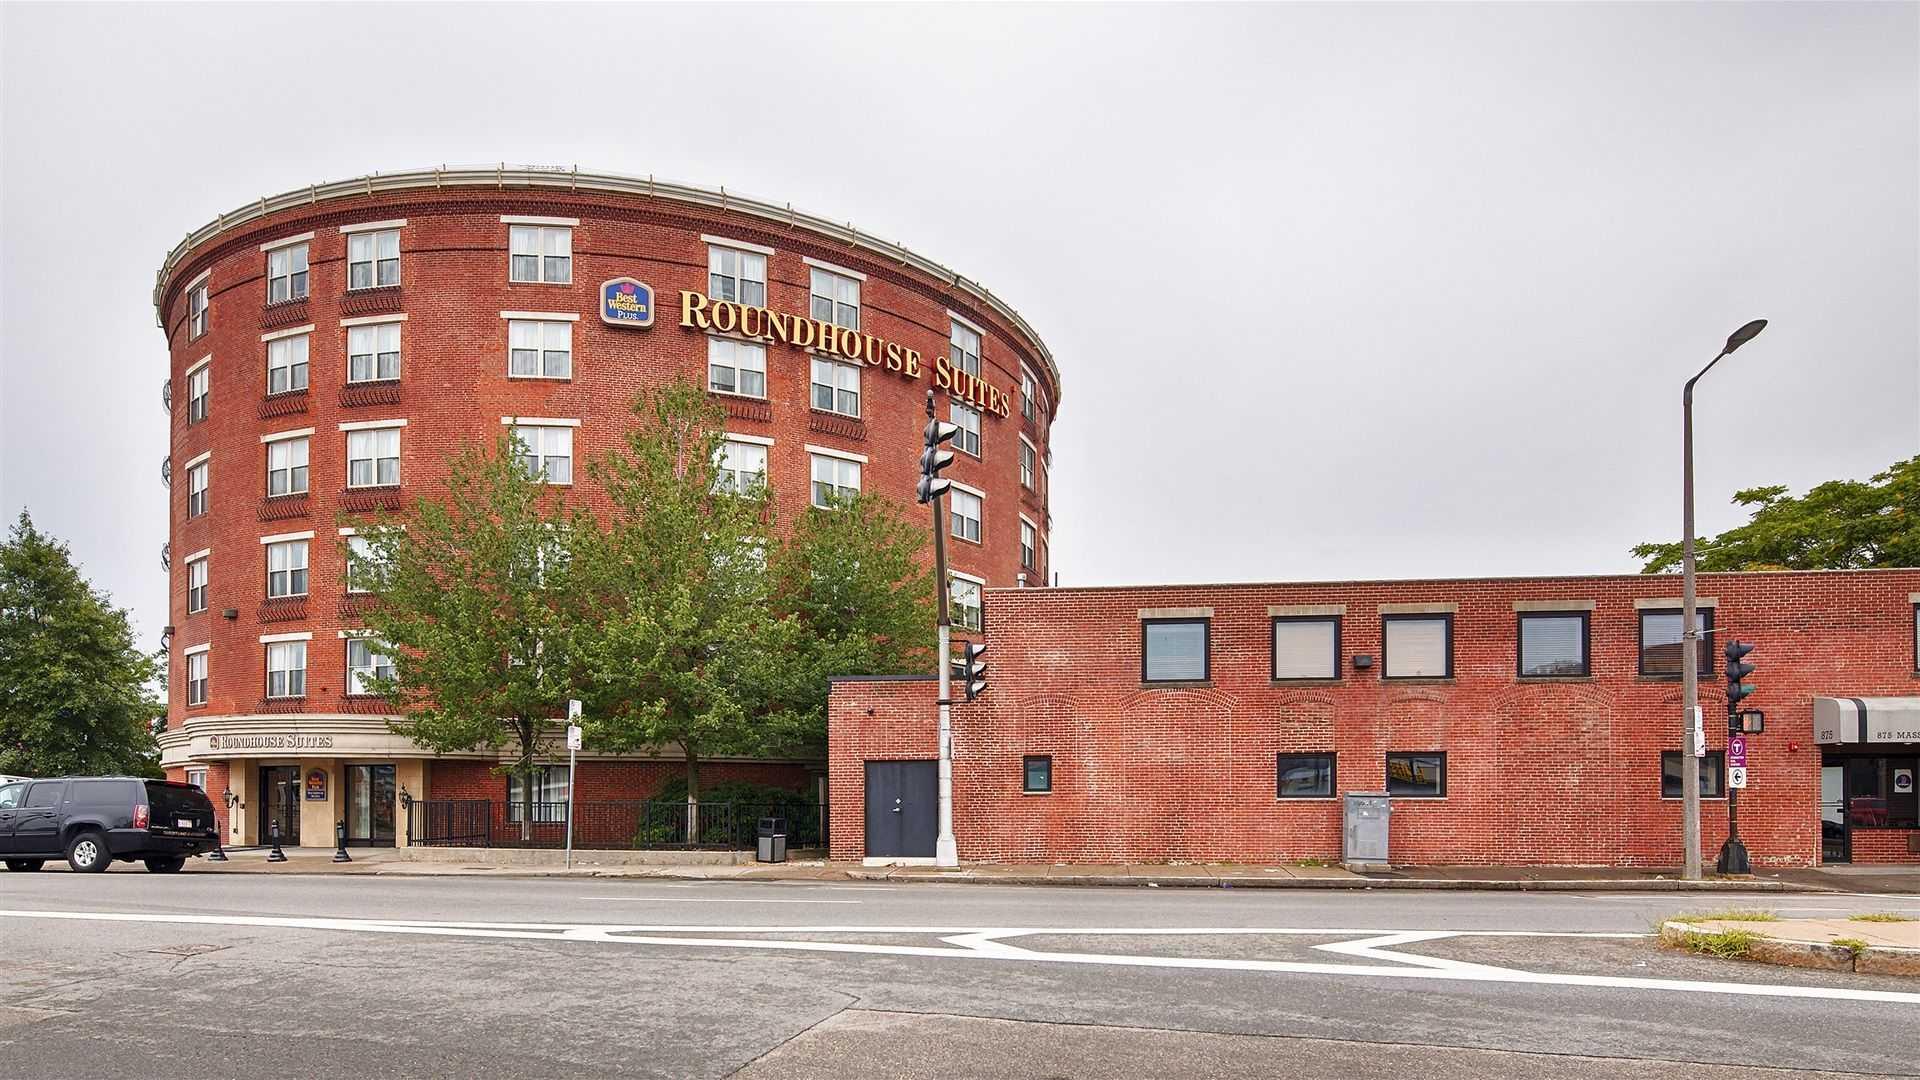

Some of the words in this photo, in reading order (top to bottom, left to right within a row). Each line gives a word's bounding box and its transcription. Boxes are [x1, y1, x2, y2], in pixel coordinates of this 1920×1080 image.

[616, 292, 638, 304] Best
[608, 299, 647, 312] Western
[679, 290, 921, 379] ROUNDHOUSE
[935, 356, 1010, 419] SUITES
[1821, 730, 1833, 740] 875
[1877, 731, 1892, 739] 875
[220, 736, 284, 749] ROUNDHOUSE
[287, 734, 333, 749] SUITES
[1733, 743, 1741, 753] T
